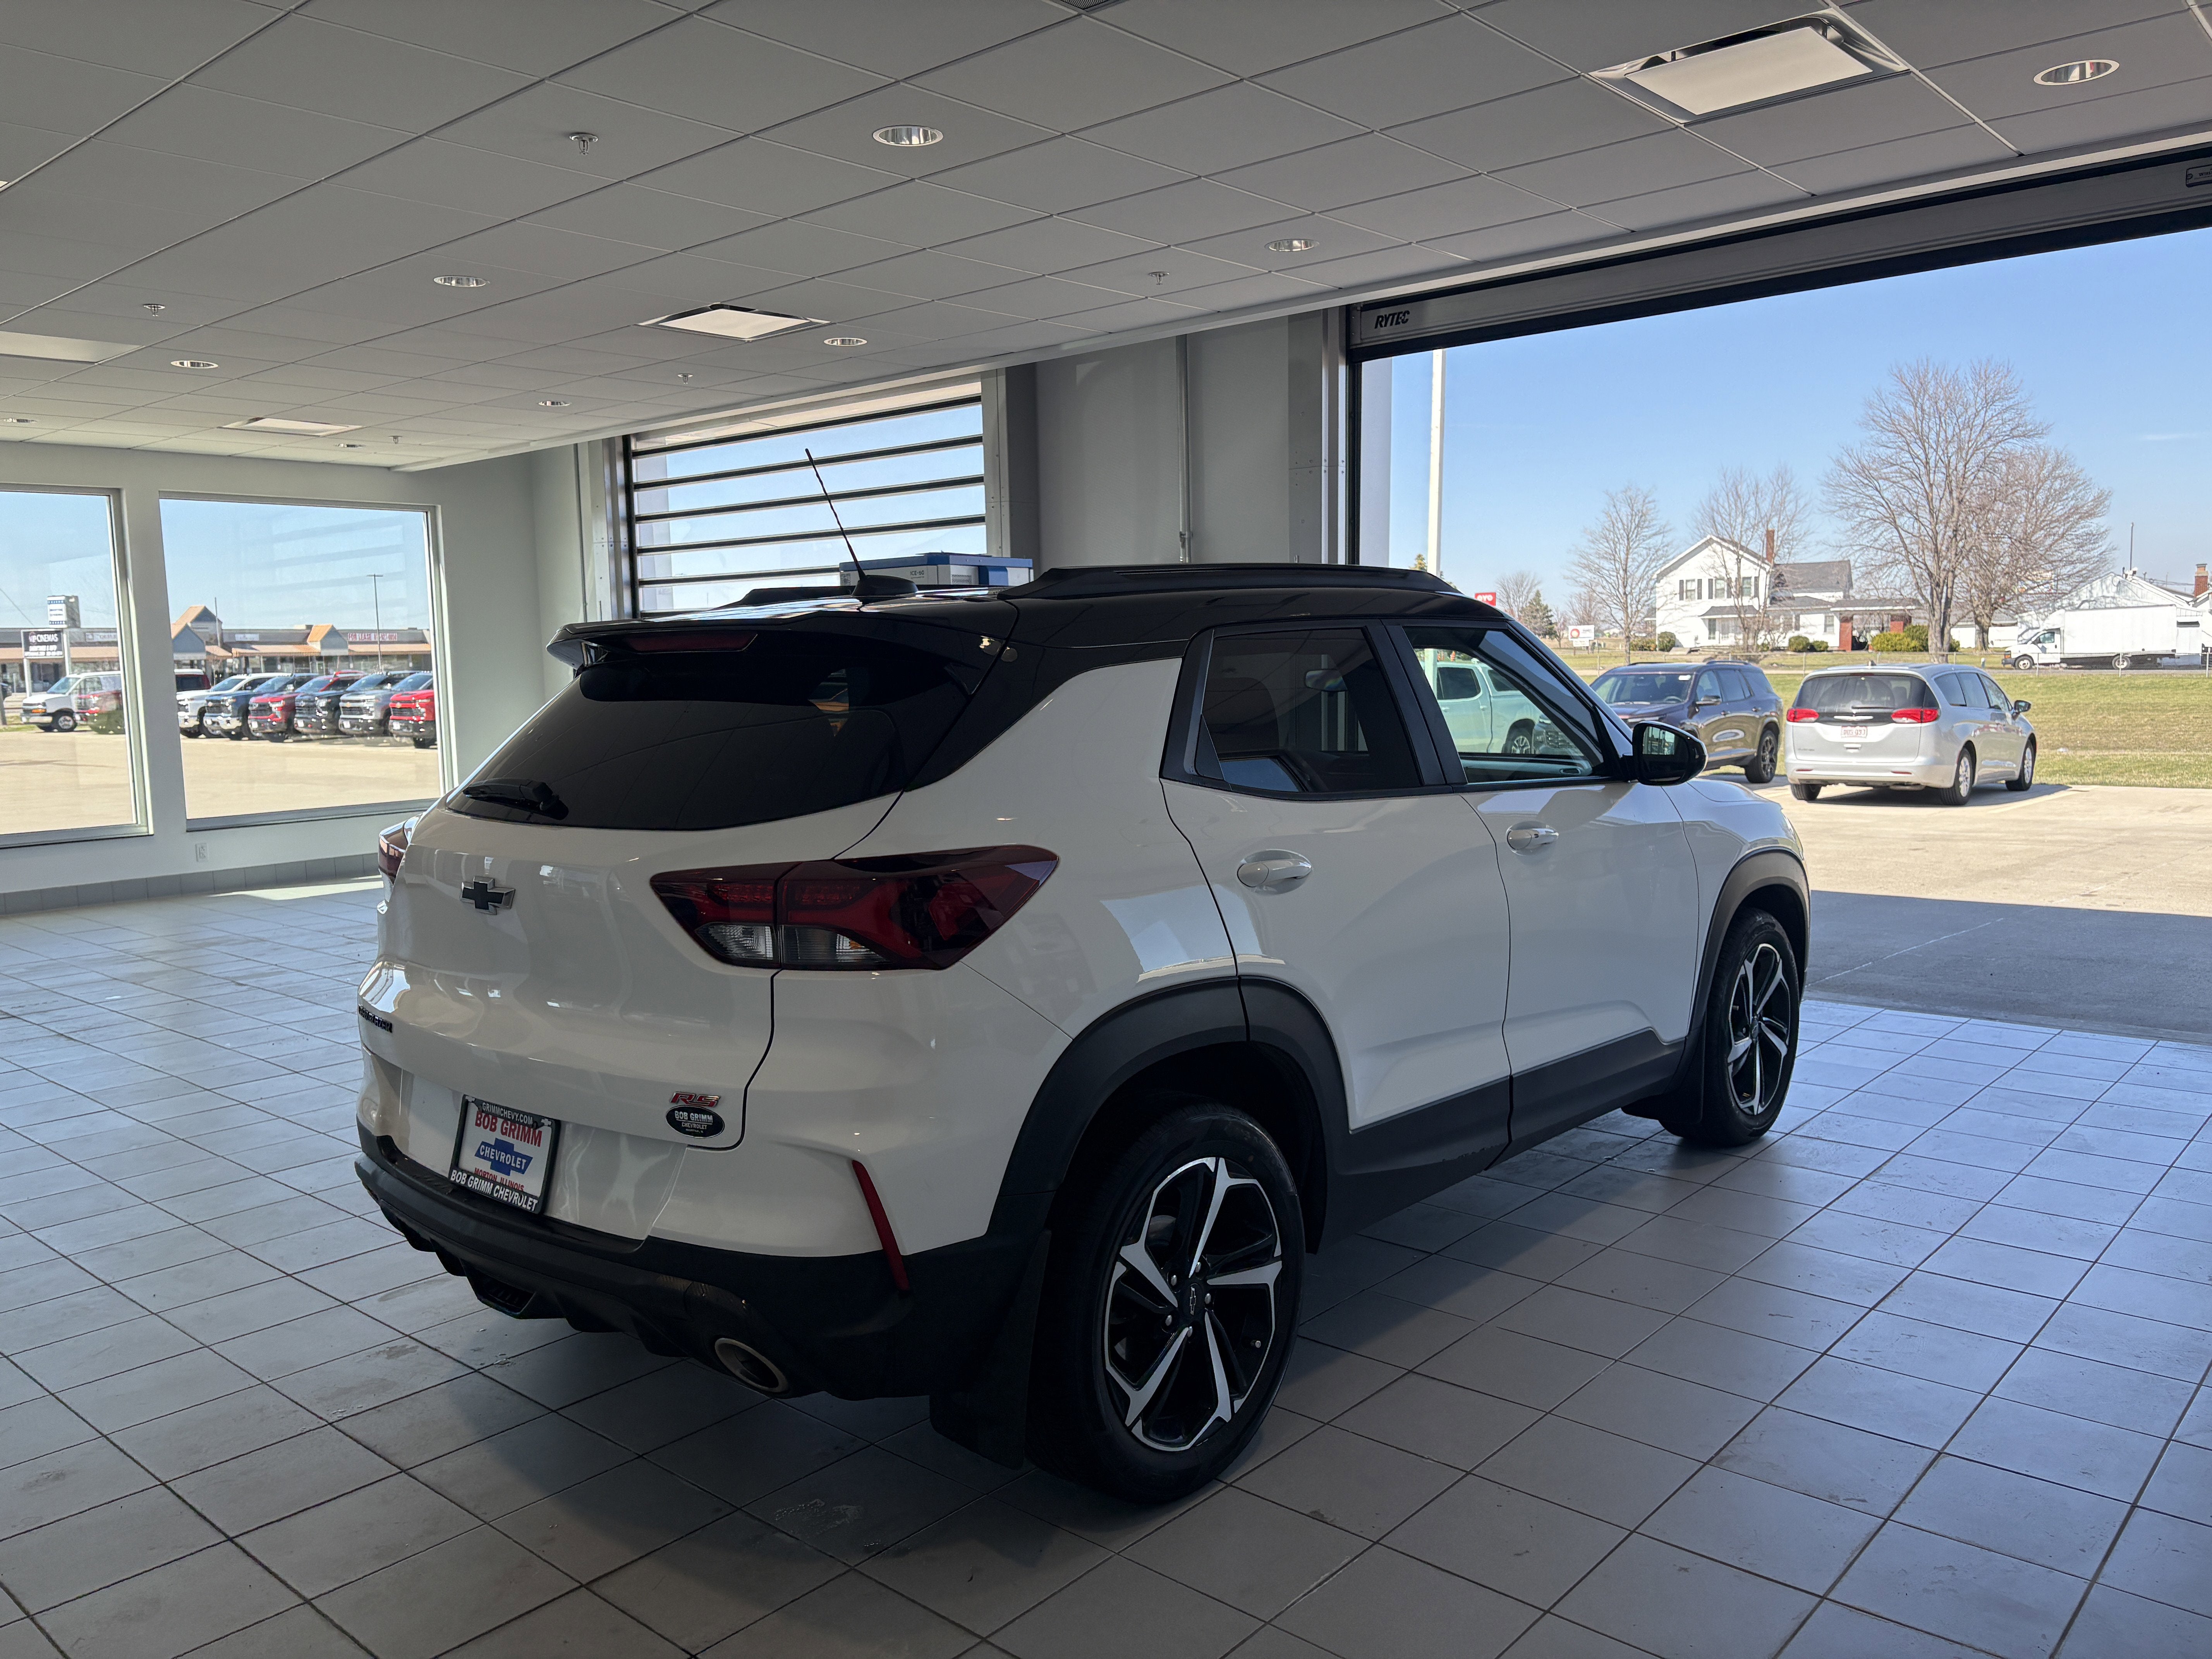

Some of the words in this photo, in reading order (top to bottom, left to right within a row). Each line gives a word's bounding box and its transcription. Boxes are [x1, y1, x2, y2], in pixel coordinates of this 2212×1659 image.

[1375, 310, 1410, 329] RYTEC
[670, 1091, 720, 1108] RS
[482, 1102, 533, 1125] GRIMMCHEVY.COM
[675, 1111, 688, 1120] BOB
[690, 1113, 713, 1123] GRIMM
[475, 1110, 498, 1132] BOB
[500, 1120, 542, 1147] GRIMM
[480, 1145, 527, 1170] CHEVROLET
[450, 1170, 467, 1185] BOB
[467, 1176, 493, 1195] GRIMM
[493, 1185, 538, 1211] CHEVROLET
[474, 1168, 497, 1181] MORTON
[500, 1177, 524, 1191] ILLINOIS
